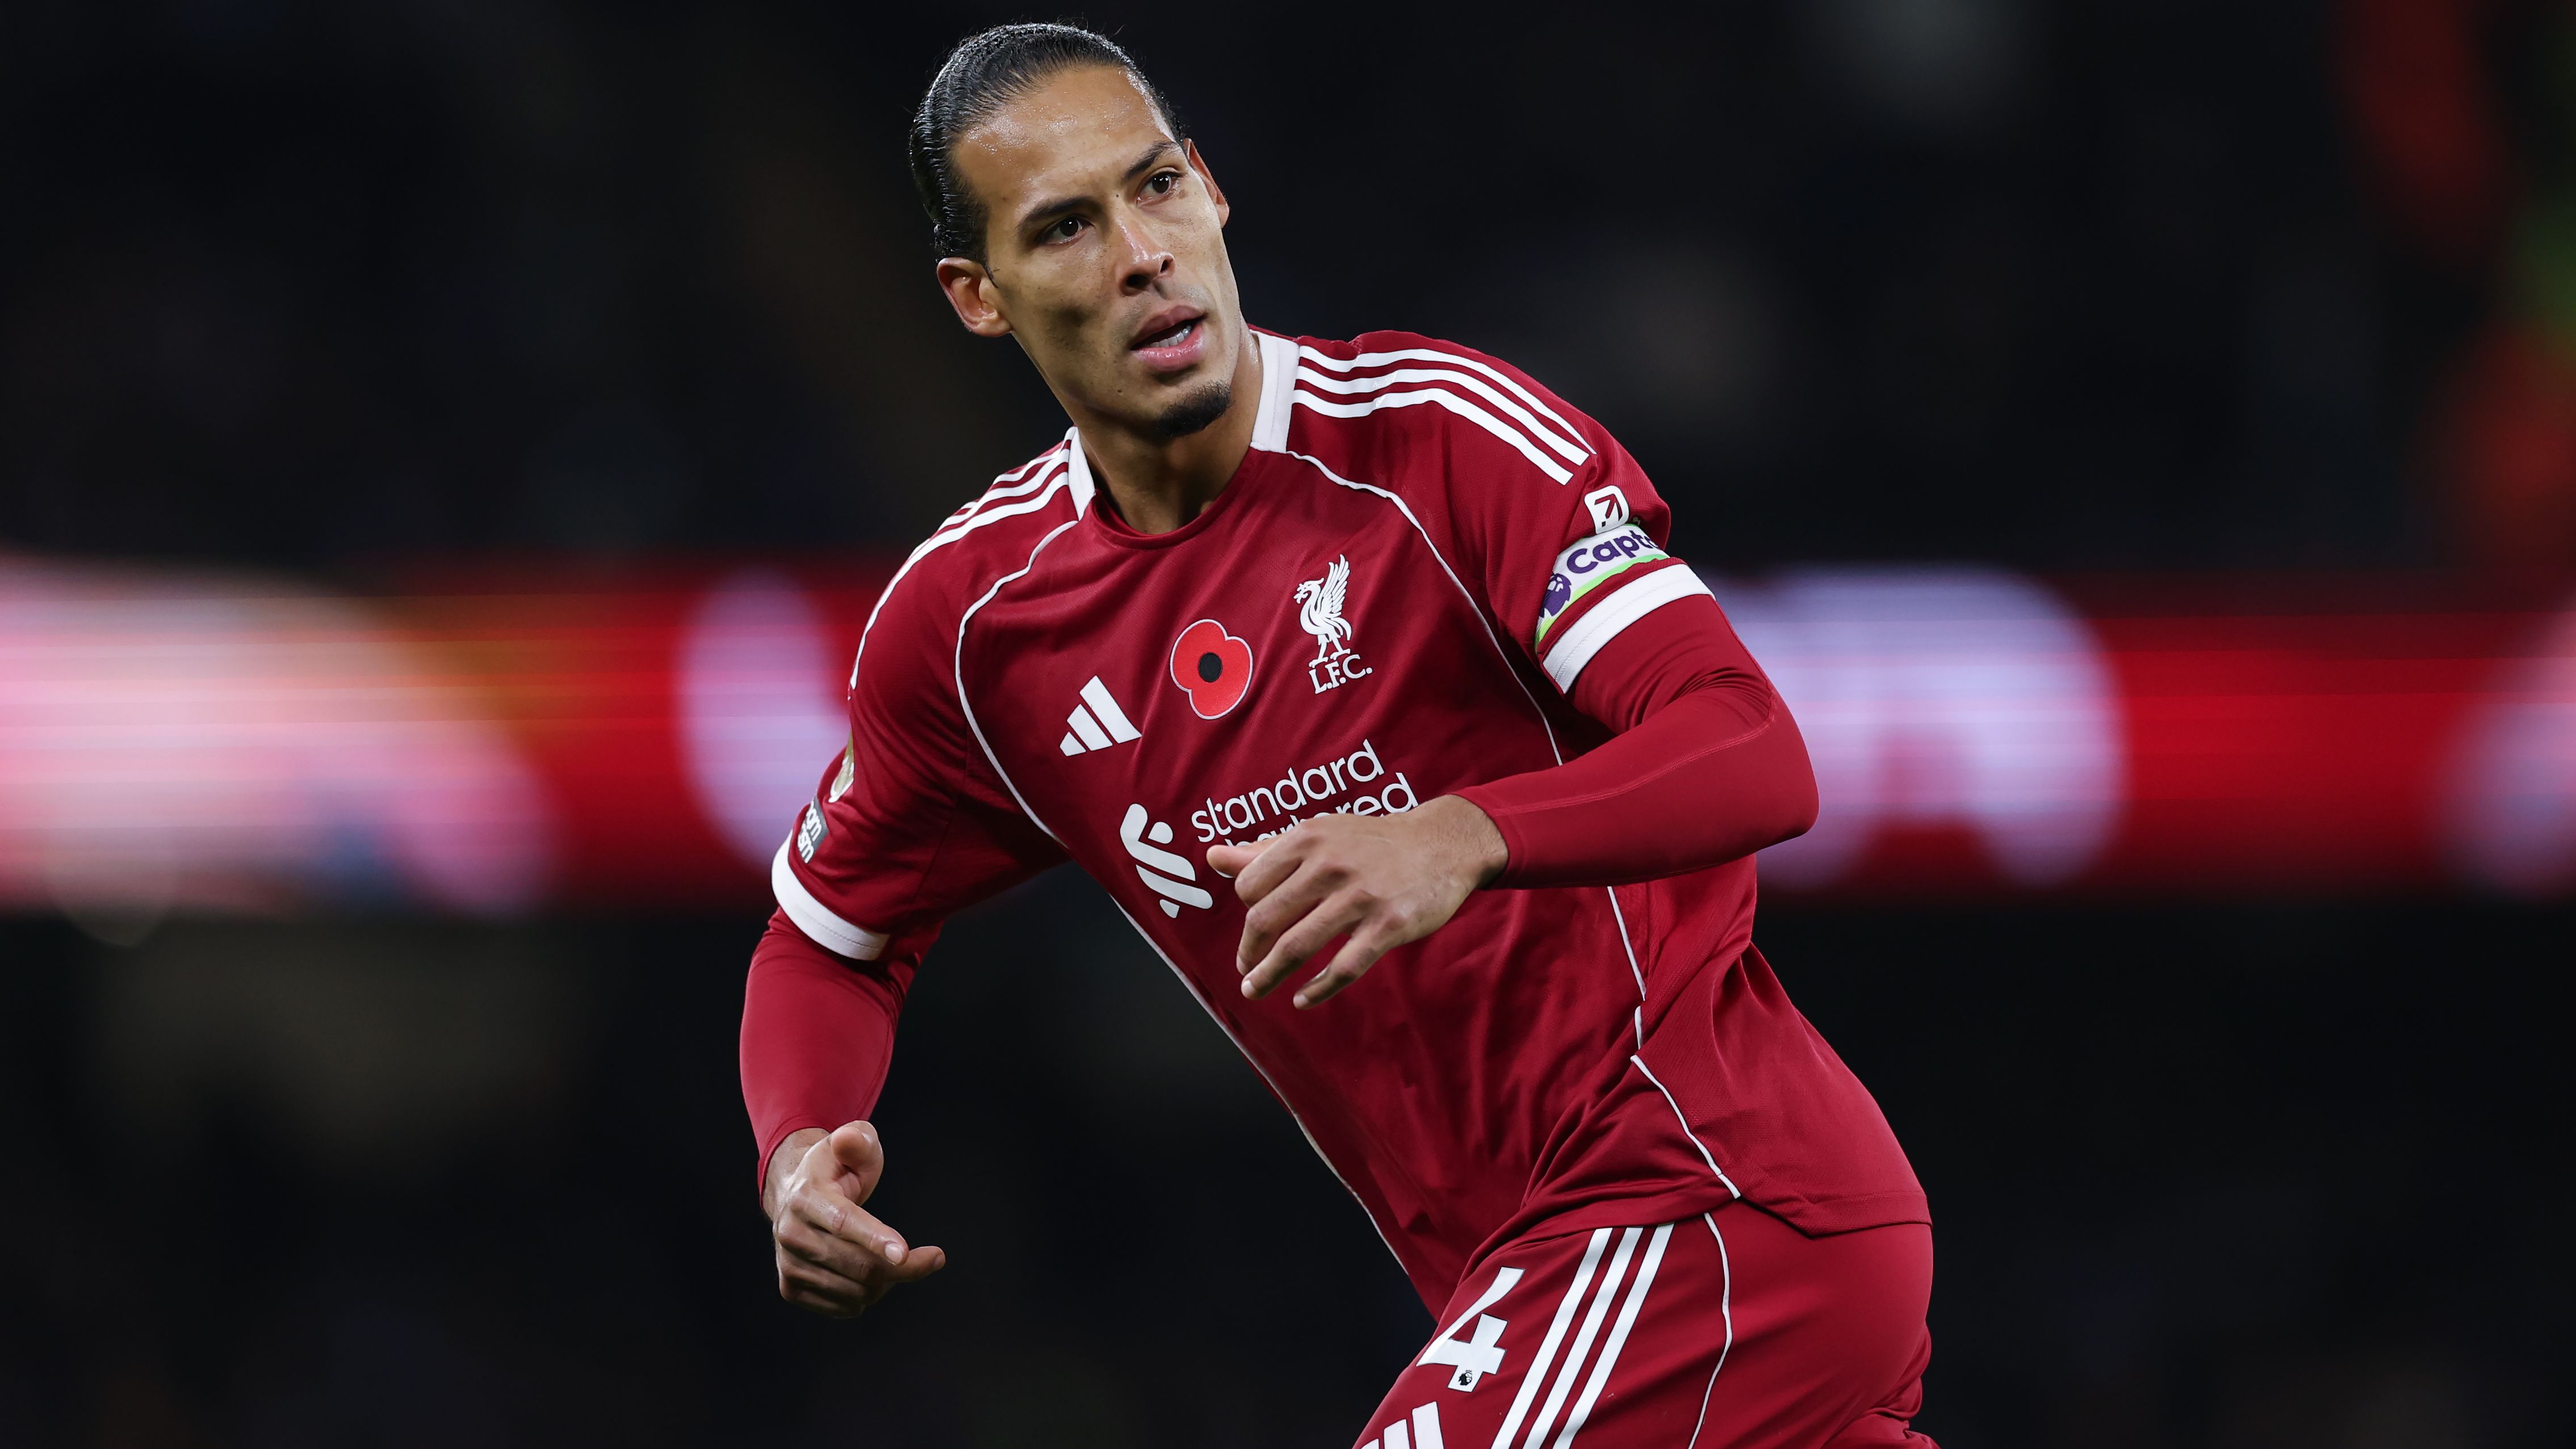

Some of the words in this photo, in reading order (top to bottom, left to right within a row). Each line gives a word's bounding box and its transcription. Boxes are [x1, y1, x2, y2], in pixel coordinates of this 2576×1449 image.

[1308, 654, 1373, 694] L.F.C.
[1191, 738, 1385, 843] standard
[1416, 1266, 1526, 1392] 4
